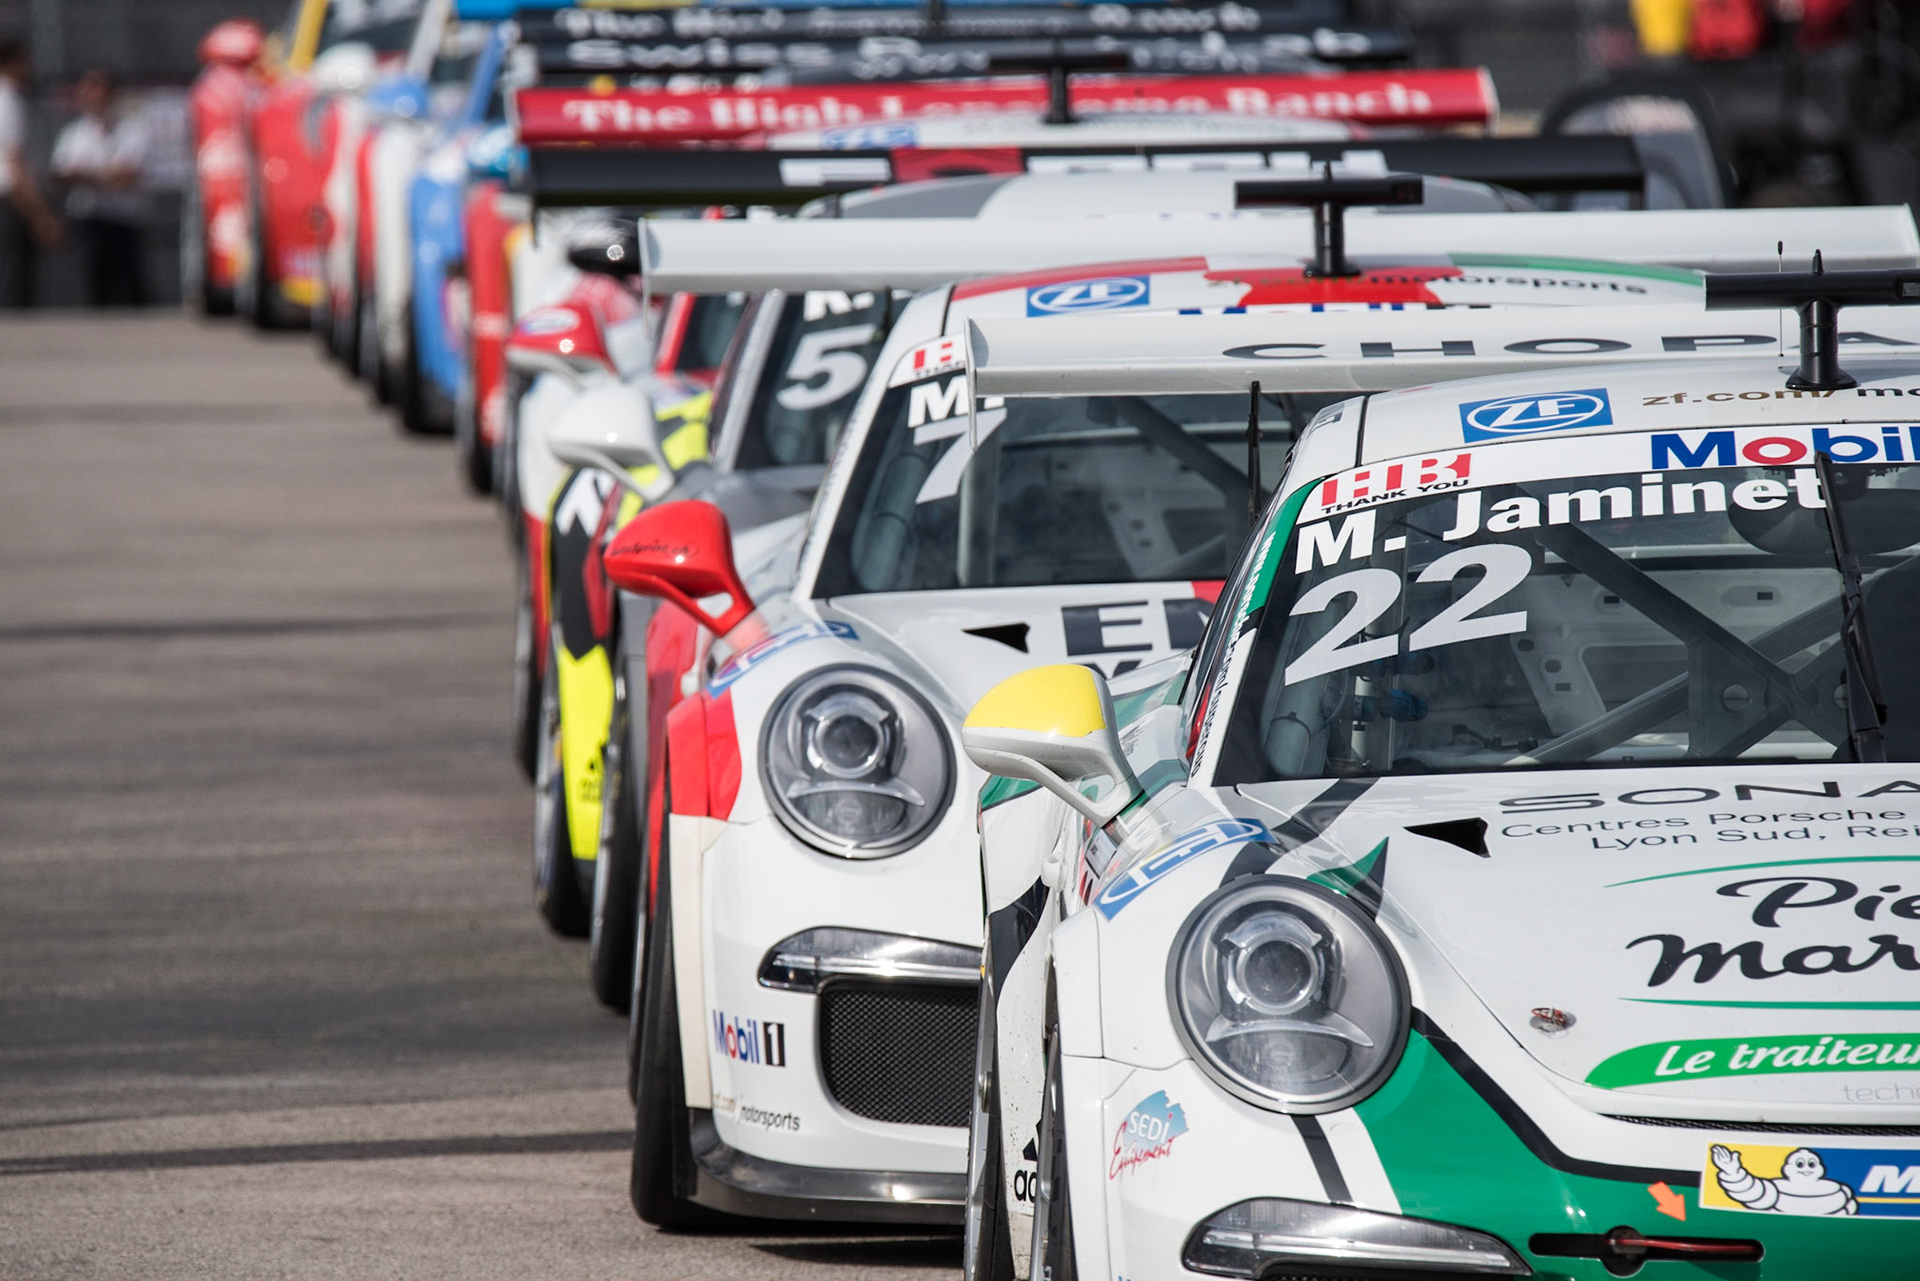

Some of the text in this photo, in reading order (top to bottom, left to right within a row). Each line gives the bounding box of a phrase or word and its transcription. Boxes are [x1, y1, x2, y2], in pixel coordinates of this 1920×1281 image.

[563, 99, 694, 131] The
[1226, 82, 1433, 116] Ranch
[1042, 283, 1136, 307] ZF
[776, 323, 875, 410] 5
[1482, 395, 1592, 429] ZF
[914, 407, 1008, 504] 7
[1651, 425, 1920, 470] Mobil
[1321, 479, 1470, 514] THANK YOU
[1295, 468, 1828, 575] M. Jaminet
[1284, 543, 1530, 686] 22
[1499, 780, 1920, 814] SONA
[1501, 808, 1907, 838] Centres Porsche
[1591, 831, 1698, 851] Lyon
[1716, 824, 1827, 842] Sud,
[1716, 877, 1920, 928] Pie
[1625, 934, 1920, 987] mar
[711, 1009, 783, 1067] Mobil 1
[1654, 1045, 1715, 1077] Le
